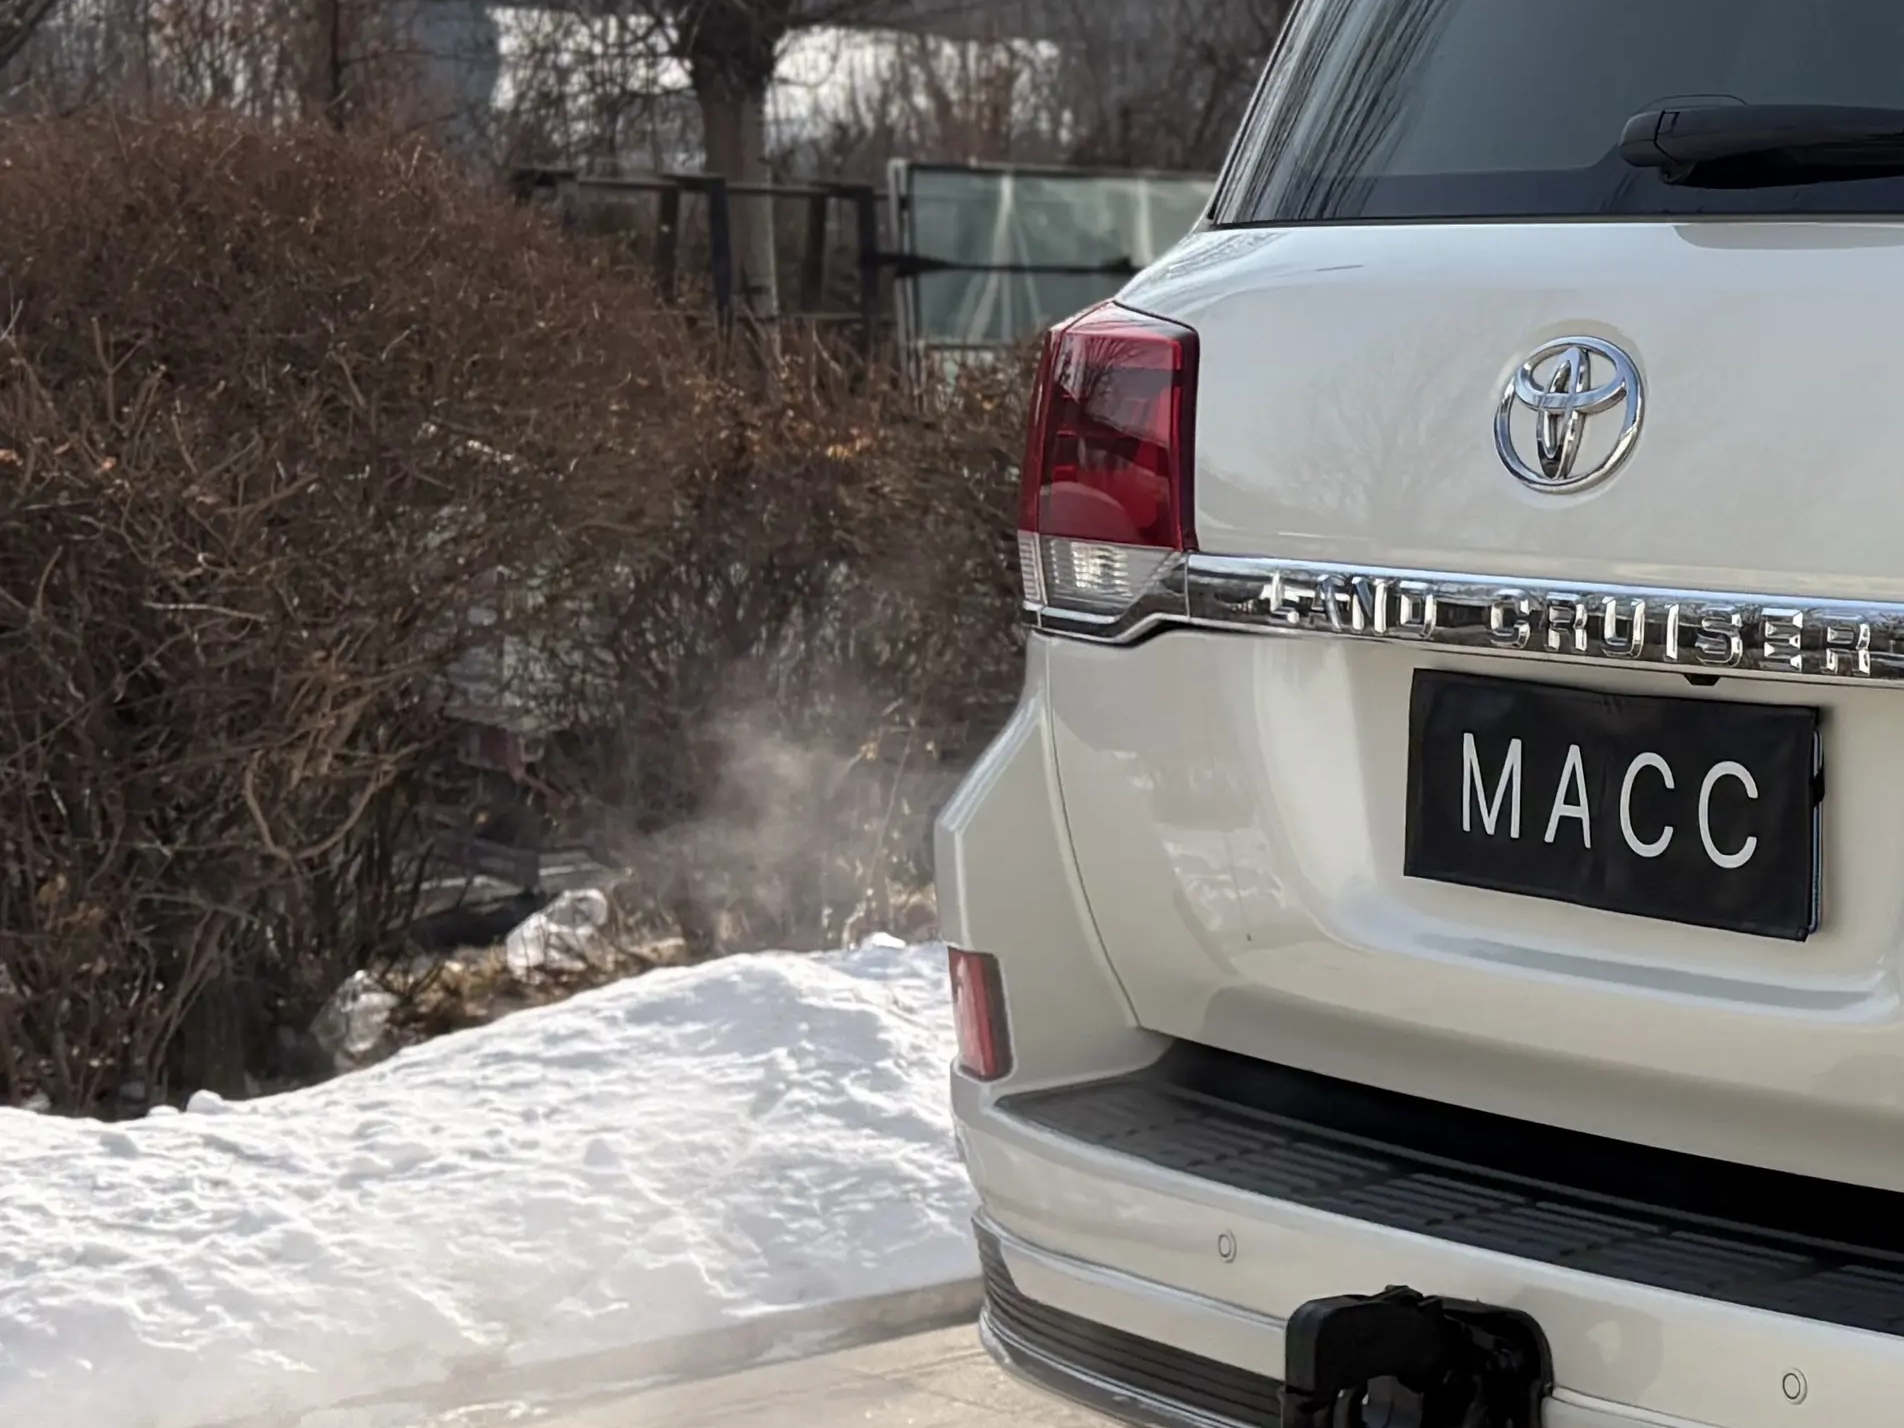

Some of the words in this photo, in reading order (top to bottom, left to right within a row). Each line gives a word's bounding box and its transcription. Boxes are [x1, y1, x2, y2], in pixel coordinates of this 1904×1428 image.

[1267, 569, 1438, 640] LAND
[1489, 586, 1871, 675] CRUISER
[1461, 731, 1759, 870] MACC
